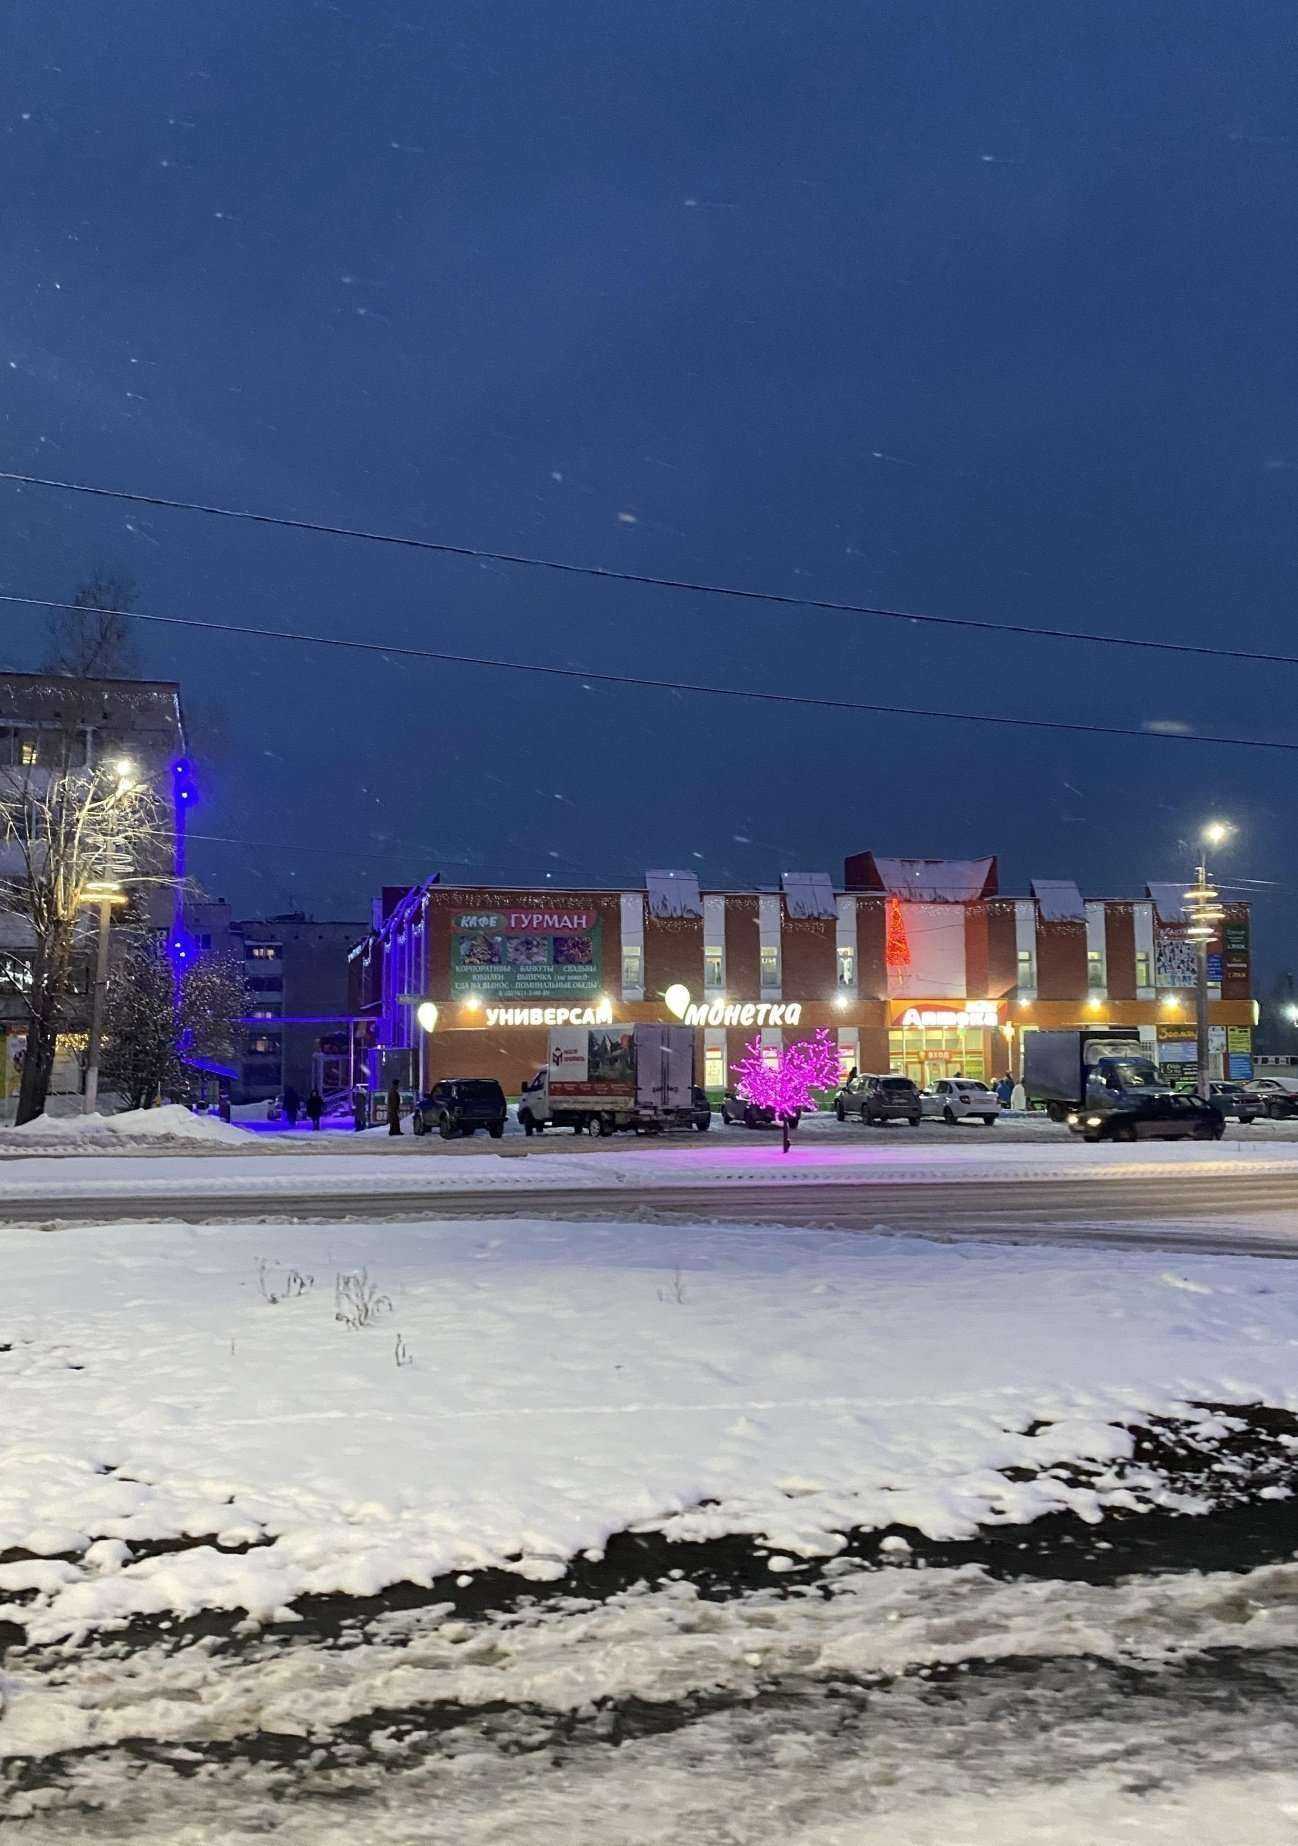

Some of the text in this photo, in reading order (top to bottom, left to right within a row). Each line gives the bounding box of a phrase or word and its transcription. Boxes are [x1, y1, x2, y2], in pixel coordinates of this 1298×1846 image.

[460, 913, 587, 929] КАФЕ ГУРМАН
[486, 1007, 613, 1025] УНИВЕРСАМ
